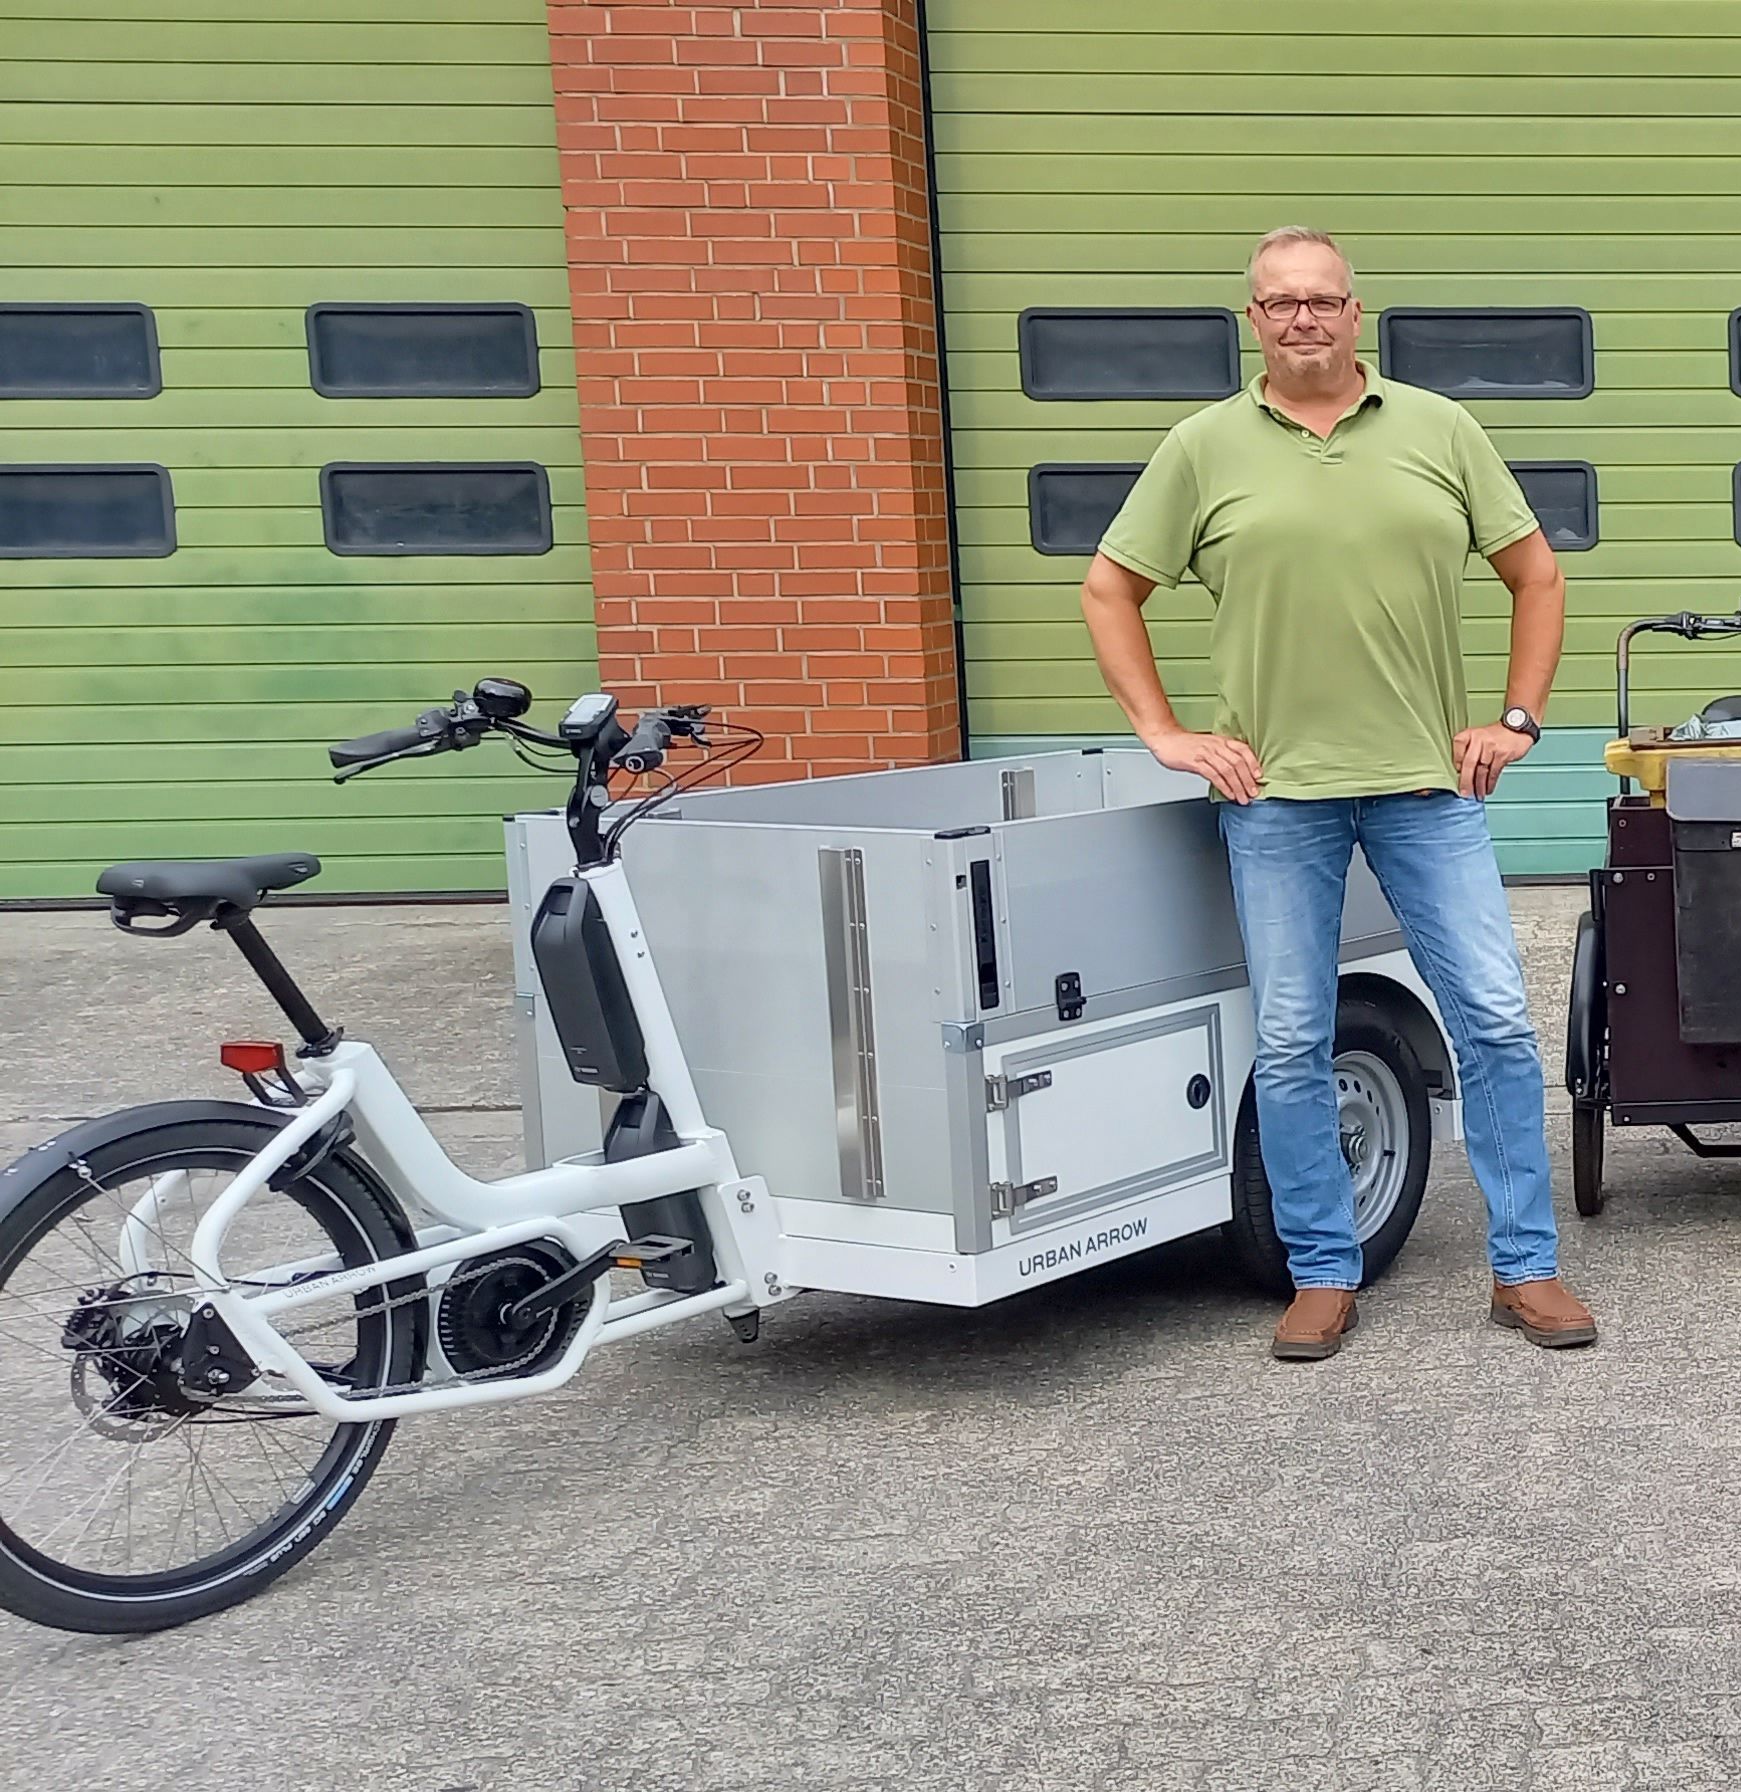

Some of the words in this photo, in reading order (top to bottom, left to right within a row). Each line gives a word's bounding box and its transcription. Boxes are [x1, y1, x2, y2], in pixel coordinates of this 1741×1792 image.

[1019, 1240, 1082, 1277] URBAN
[1085, 1217, 1148, 1255] ARROW
[283, 1280, 329, 1298] URBAN
[331, 1266, 377, 1284] ARROW
